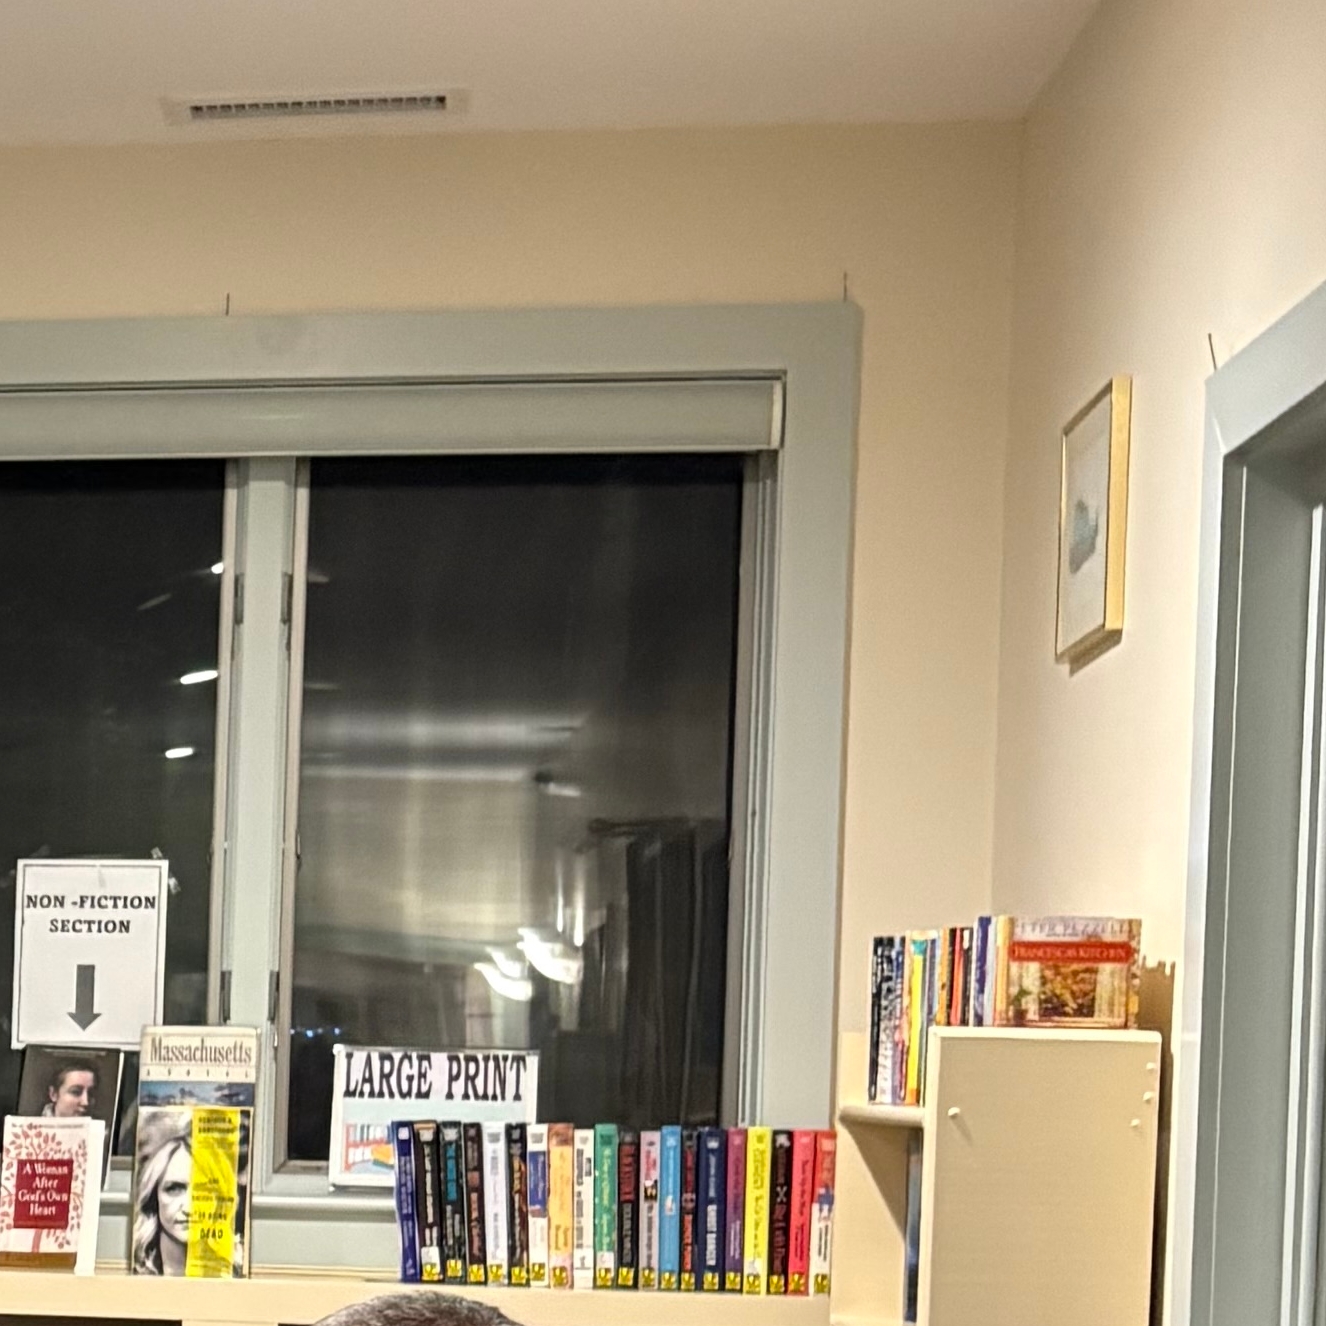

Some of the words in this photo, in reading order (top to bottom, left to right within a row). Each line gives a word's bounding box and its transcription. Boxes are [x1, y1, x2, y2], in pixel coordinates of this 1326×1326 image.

[25, 894, 65, 909] NON
[49, 918, 131, 934] SECTION
[150, 1036, 252, 1065] Massachusetts
[343, 1051, 432, 1100] LARGE
[445, 1053, 527, 1102] PRINT
